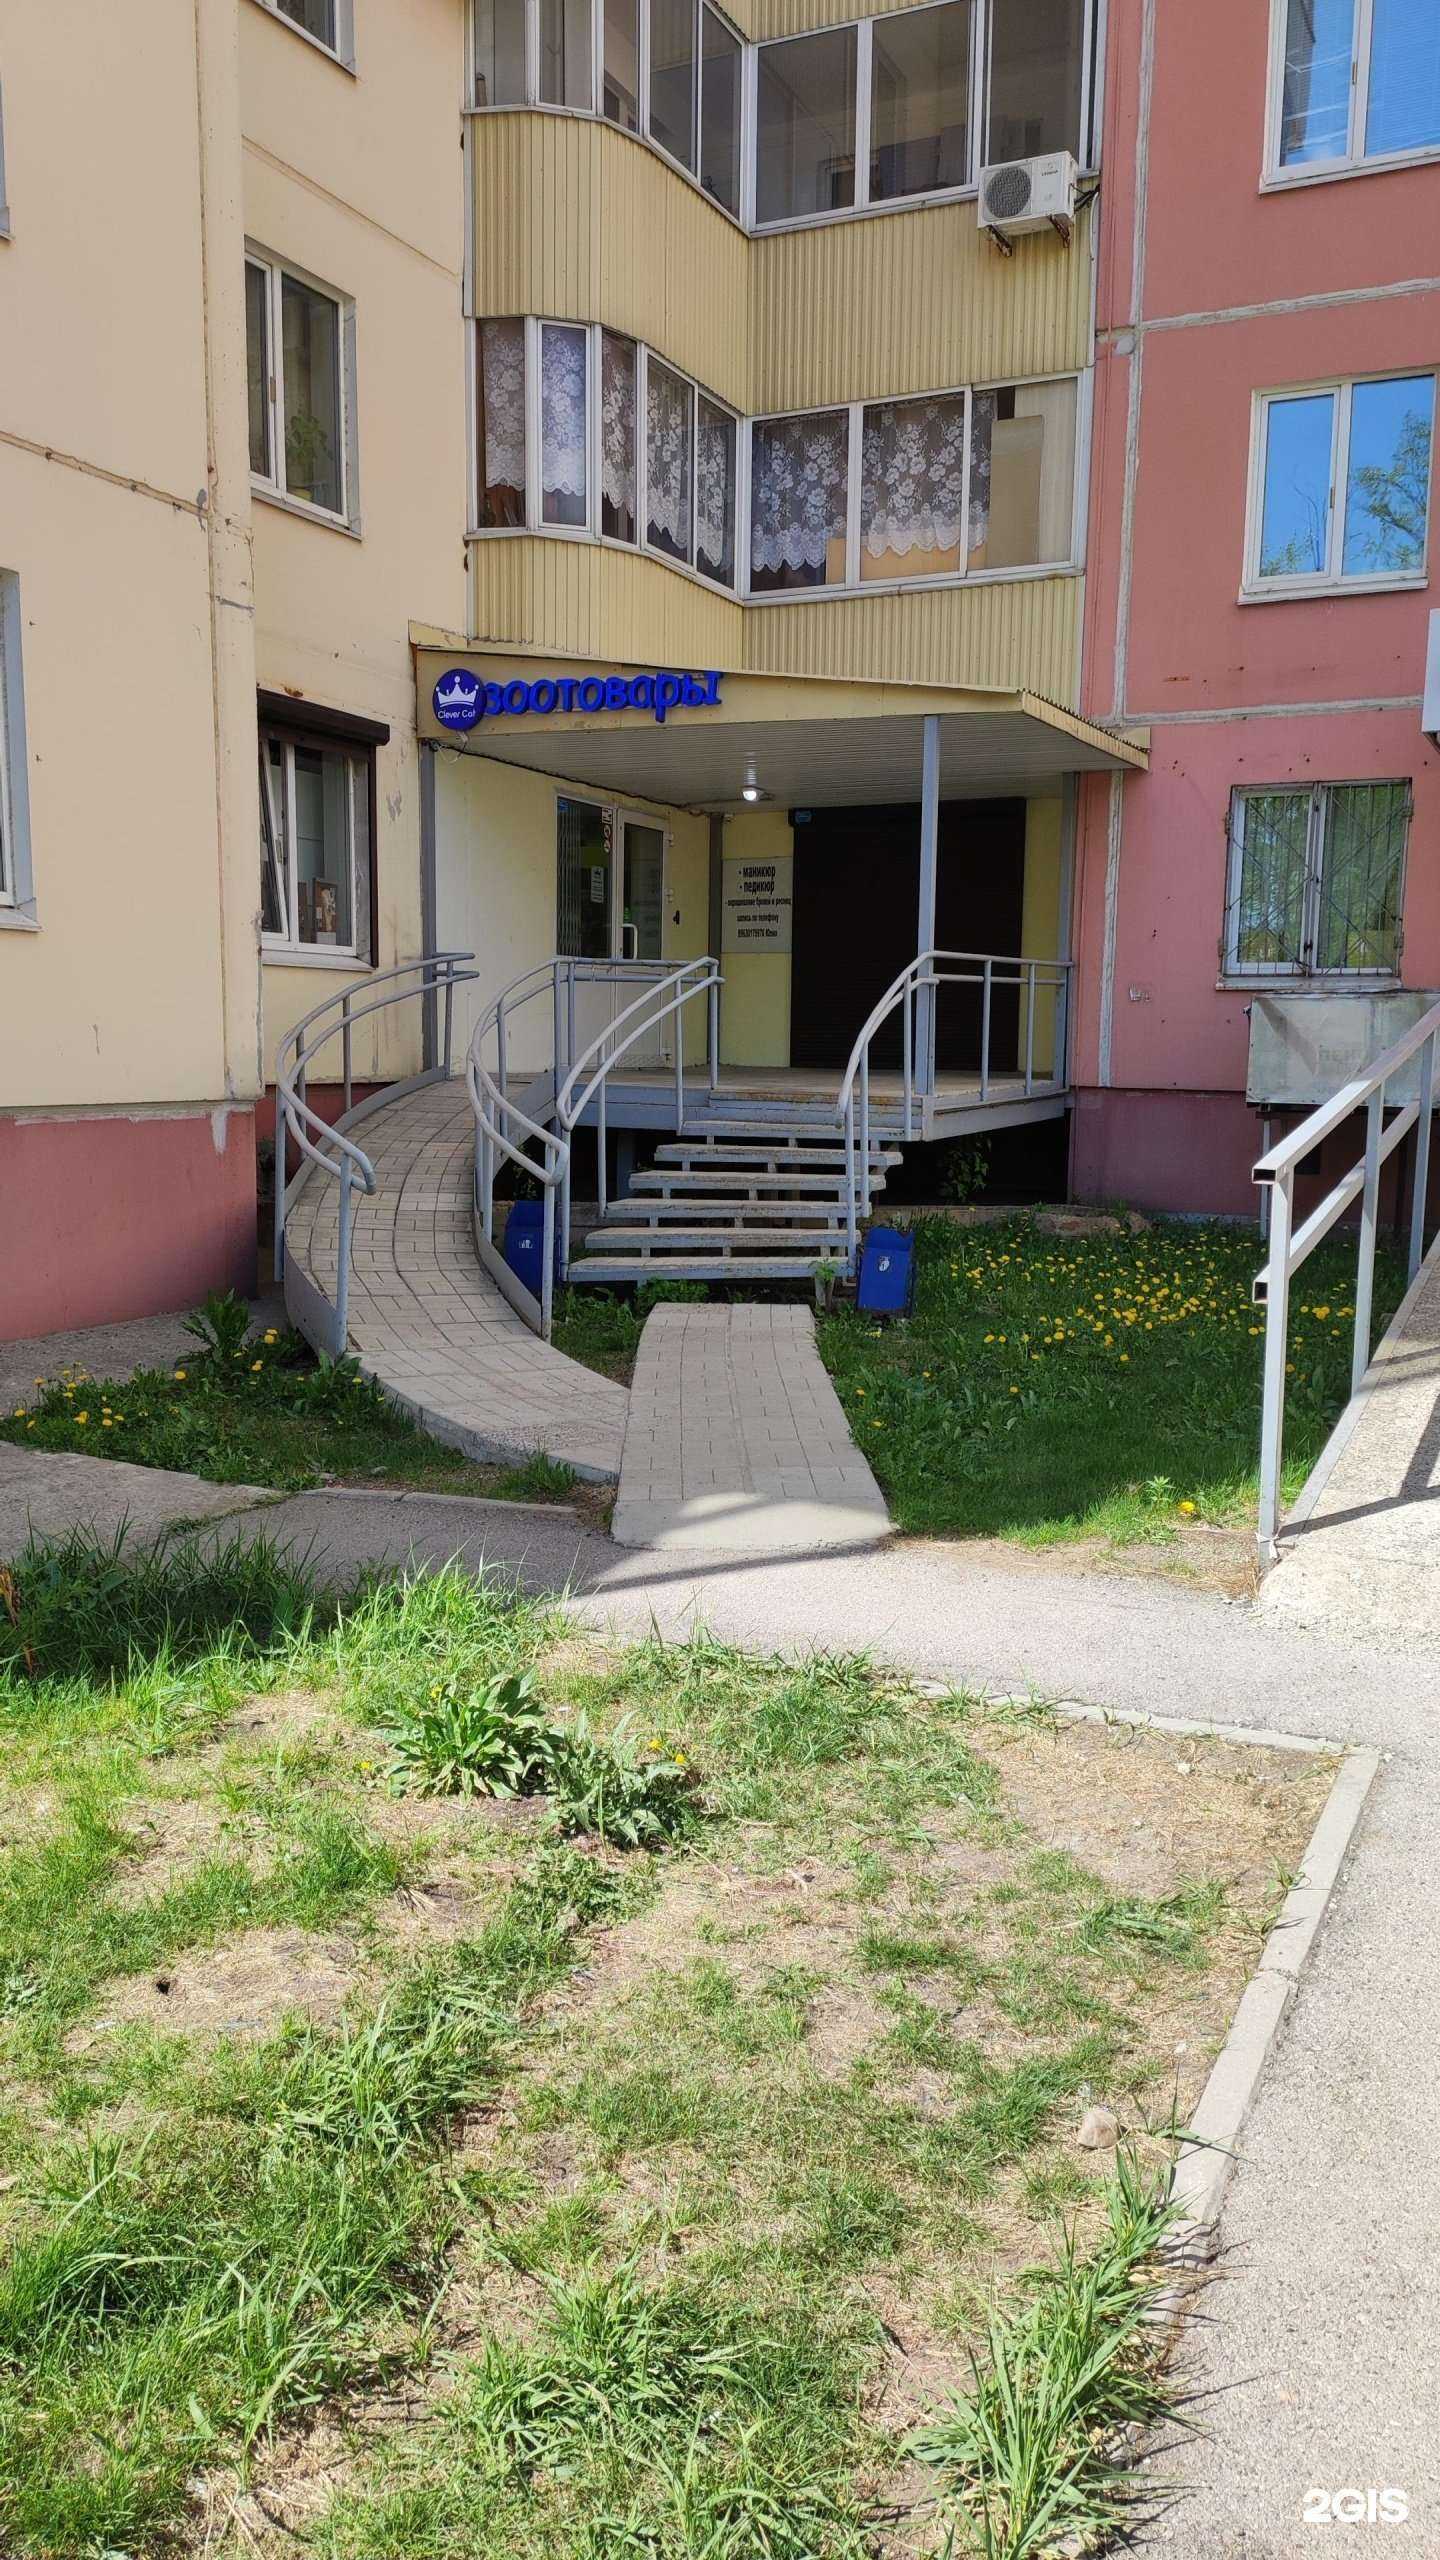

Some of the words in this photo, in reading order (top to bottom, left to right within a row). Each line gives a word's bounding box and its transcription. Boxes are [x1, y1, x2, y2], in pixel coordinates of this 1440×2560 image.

[484, 670, 724, 722] зоотовары
[437, 710, 461, 719] Clever
[743, 866, 776, 880] маникюр
[744, 881, 775, 895] педикюр
